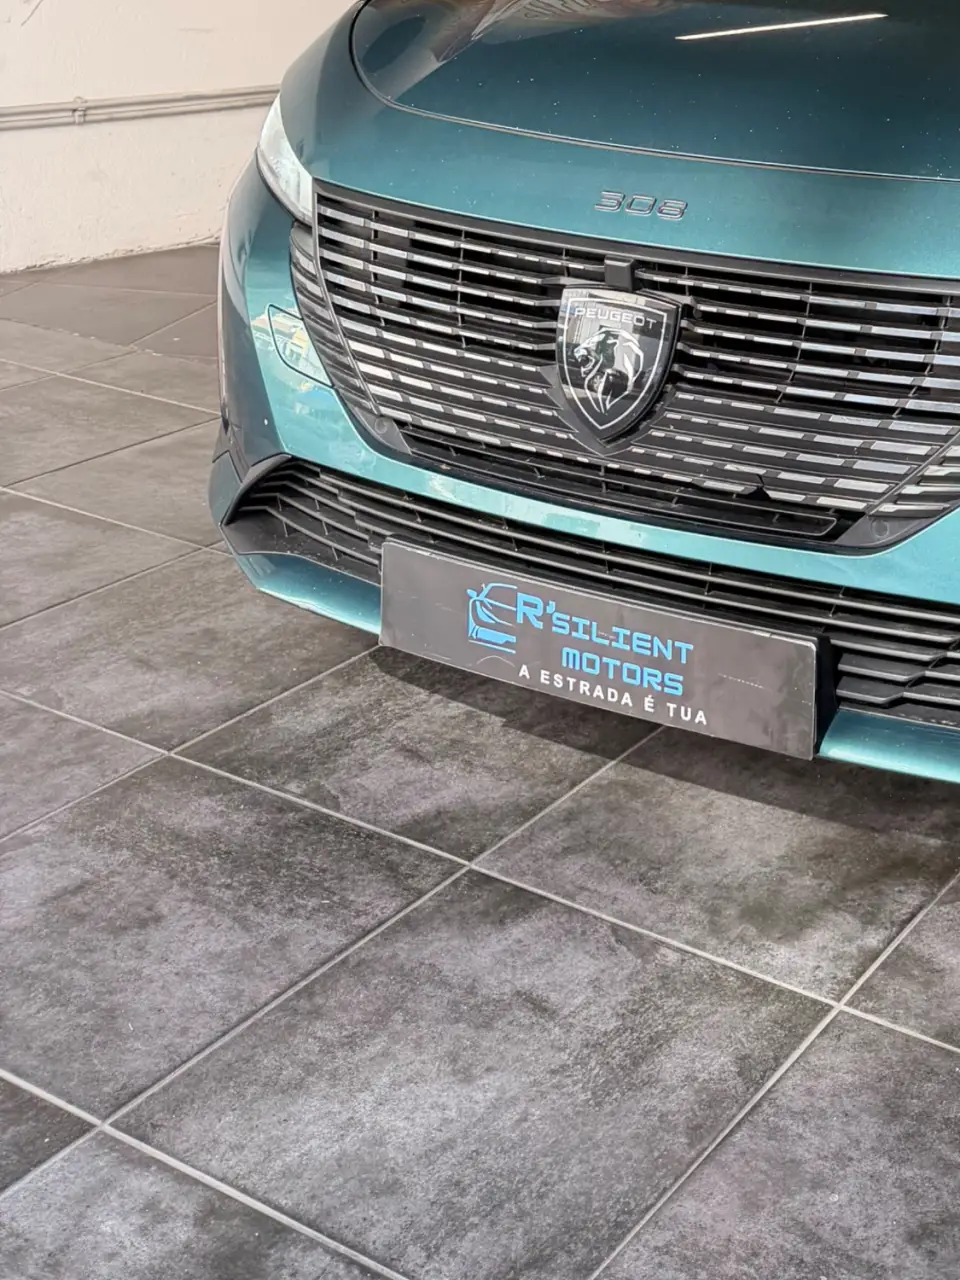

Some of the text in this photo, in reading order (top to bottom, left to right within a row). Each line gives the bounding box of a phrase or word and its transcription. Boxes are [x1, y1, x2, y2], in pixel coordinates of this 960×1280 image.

[594, 191, 689, 221] 308
[574, 307, 658, 329] PEUGEOT
[516, 592, 694, 664] R'SILIENT
[518, 664, 707, 725] A ESTRADA É TUA
[561, 647, 685, 696] MOTORS
